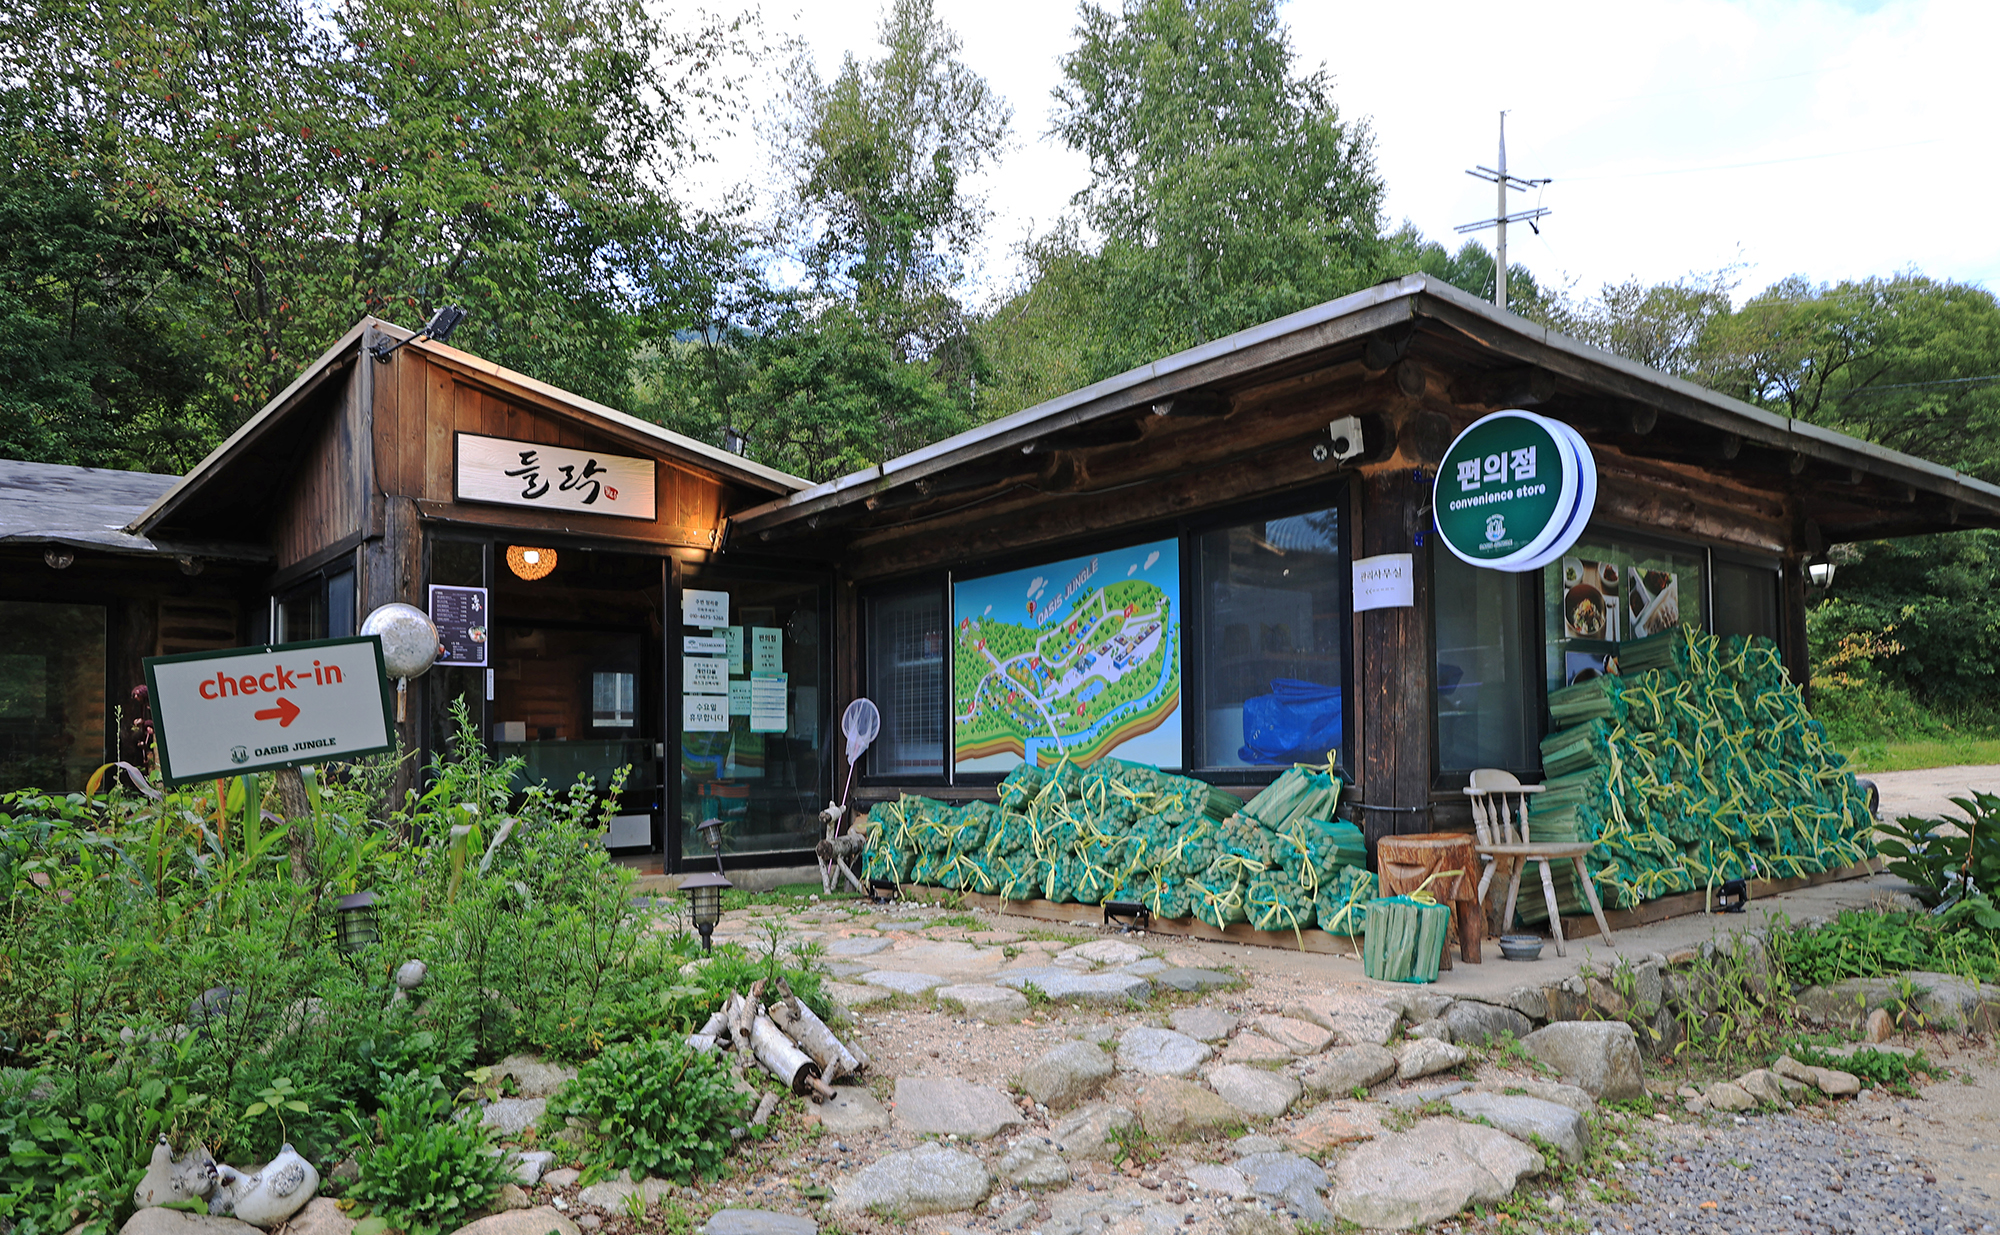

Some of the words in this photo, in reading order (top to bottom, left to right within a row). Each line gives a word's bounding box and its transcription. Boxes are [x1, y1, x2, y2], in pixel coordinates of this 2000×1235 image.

[504, 449, 607, 505] 들락
[1456, 445, 1537, 492] 편의점
[1449, 489, 1514, 511] convenience
[1516, 483, 1546, 498] store
[1036, 593, 1063, 626] OASIS
[1063, 557, 1098, 600] JUNGLE
[198, 659, 343, 700] check-in
[689, 713, 724, 722] 휴무합니다
[696, 703, 717, 711] 수요일
[254, 744, 289, 757] OASIS
[292, 737, 337, 752] JUNGLE
